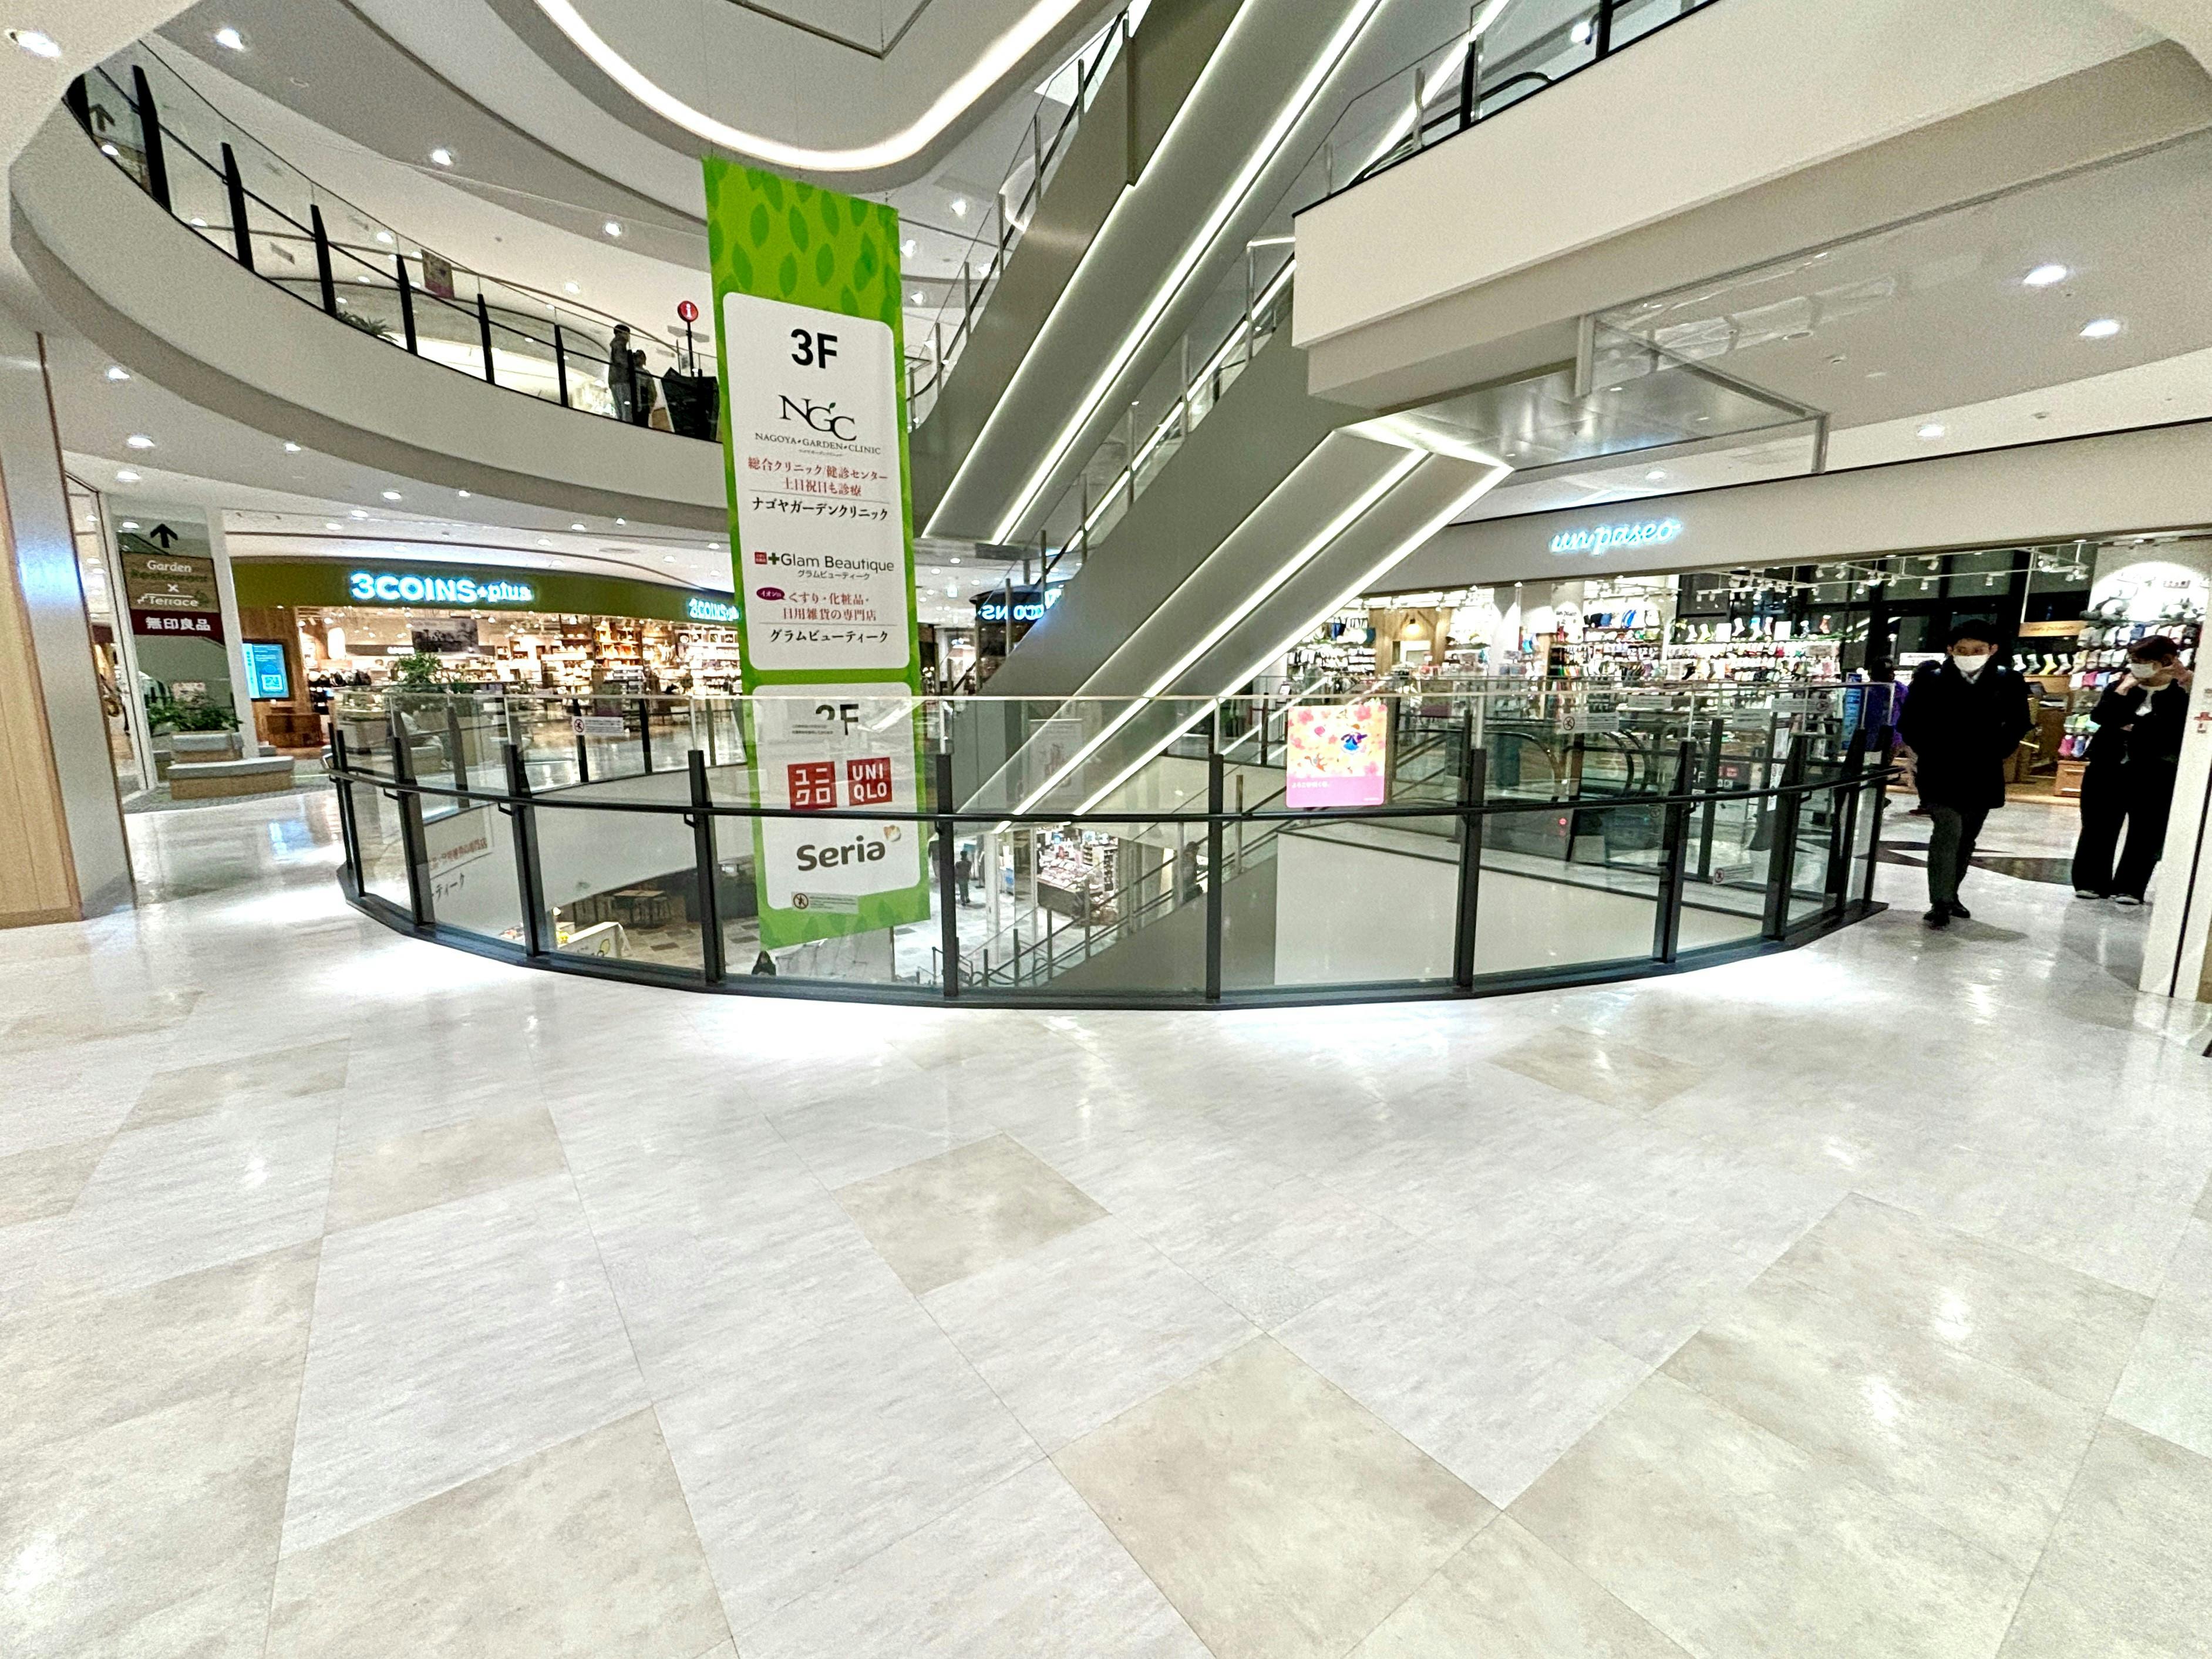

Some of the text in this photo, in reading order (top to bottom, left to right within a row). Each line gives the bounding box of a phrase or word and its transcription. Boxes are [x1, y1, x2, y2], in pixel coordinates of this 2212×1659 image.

[791, 329, 837, 369] 3F
[778, 395, 857, 441] NGC
[748, 456, 888, 481] 総合クリニック 健診センター
[783, 477, 861, 497] 土日祝日も診療
[752, 497, 888, 520] ナゴヤガーデンクリニック
[147, 560, 192, 573] Garden
[780, 553, 820, 568] Glam
[824, 556, 894, 574] Beautique
[797, 570, 870, 580] グラムビューティーク
[149, 596, 199, 607] Terrace
[146, 617, 211, 631] 無印良品
[783, 608, 877, 621] 日用雑貨の専門店
[770, 628, 888, 643] グラムビューティーク
[852, 763, 884, 781] UNI
[853, 782, 888, 801] QLO
[796, 835, 886, 871] Seria
